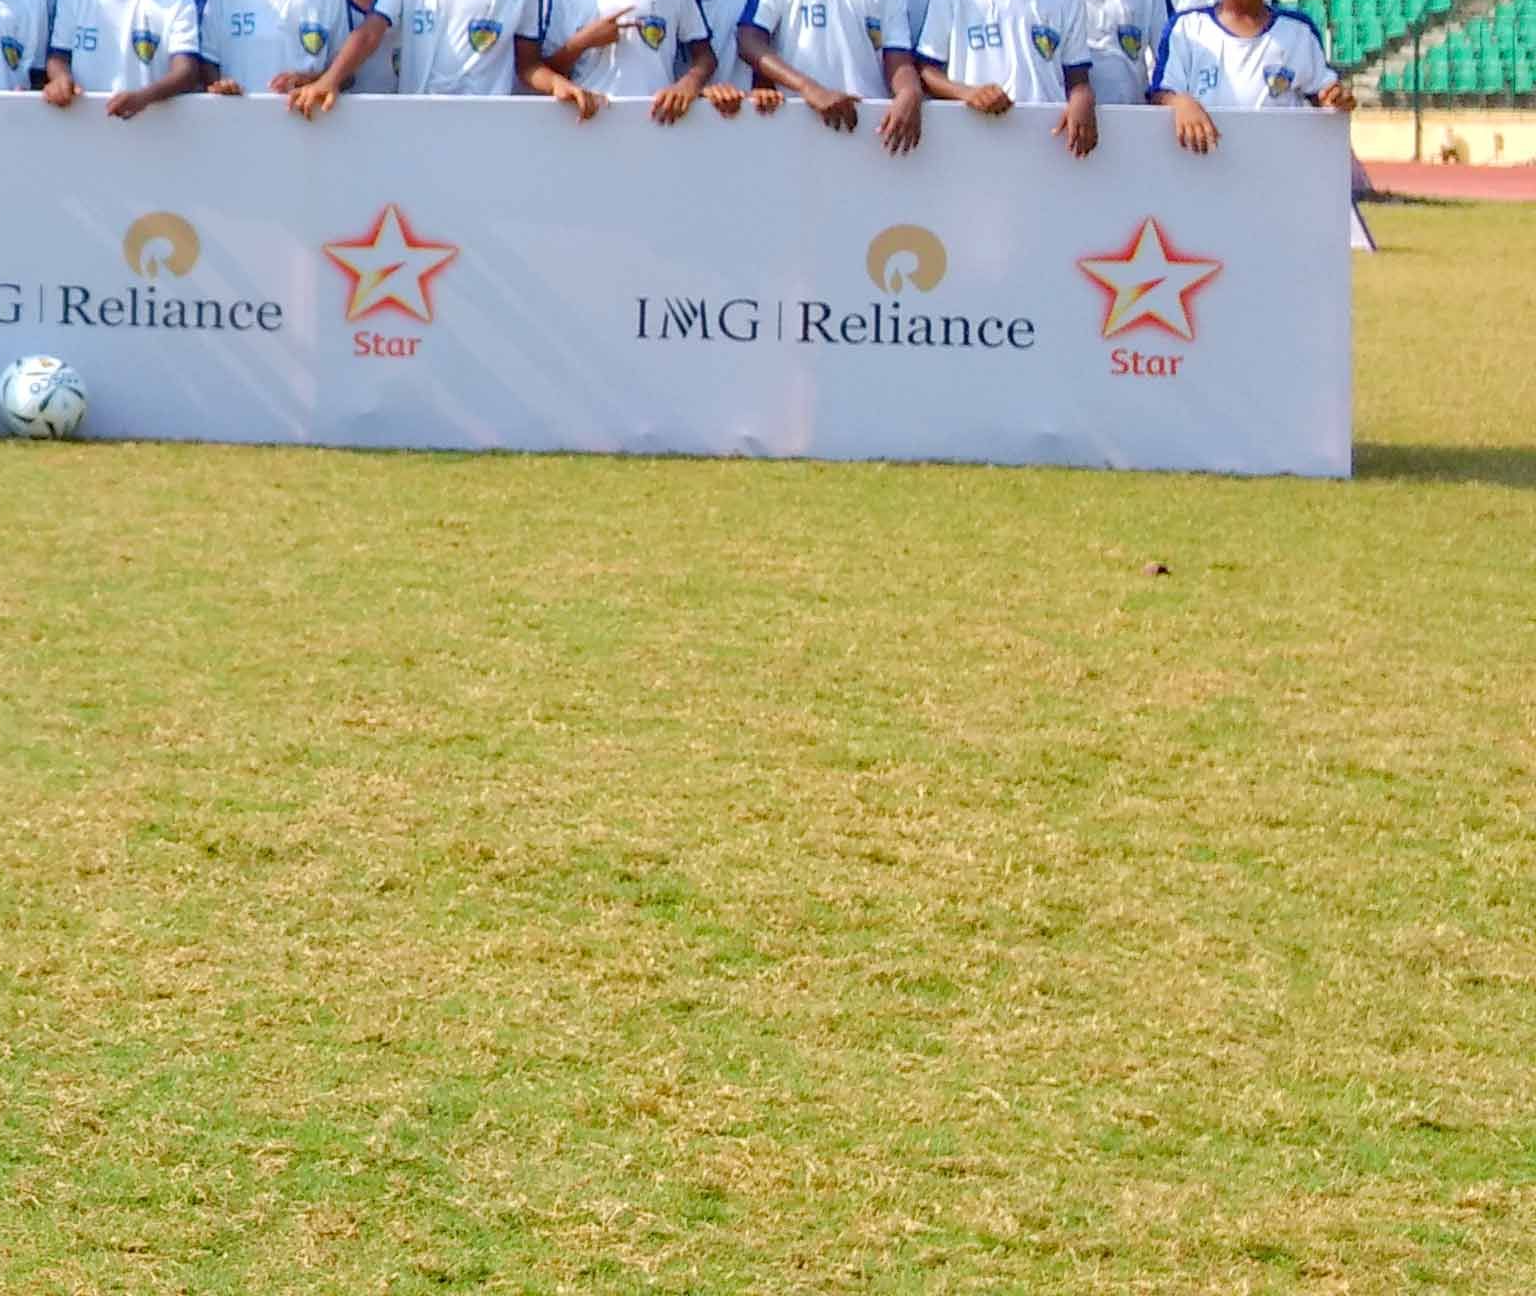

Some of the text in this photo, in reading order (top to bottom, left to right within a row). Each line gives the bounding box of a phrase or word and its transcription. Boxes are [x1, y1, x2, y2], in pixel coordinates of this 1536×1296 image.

[59, 284, 283, 333] Reliance
[636, 297, 1036, 349] IMG Reliance
[352, 329, 423, 358] Star
[1110, 347, 1184, 377] Star
